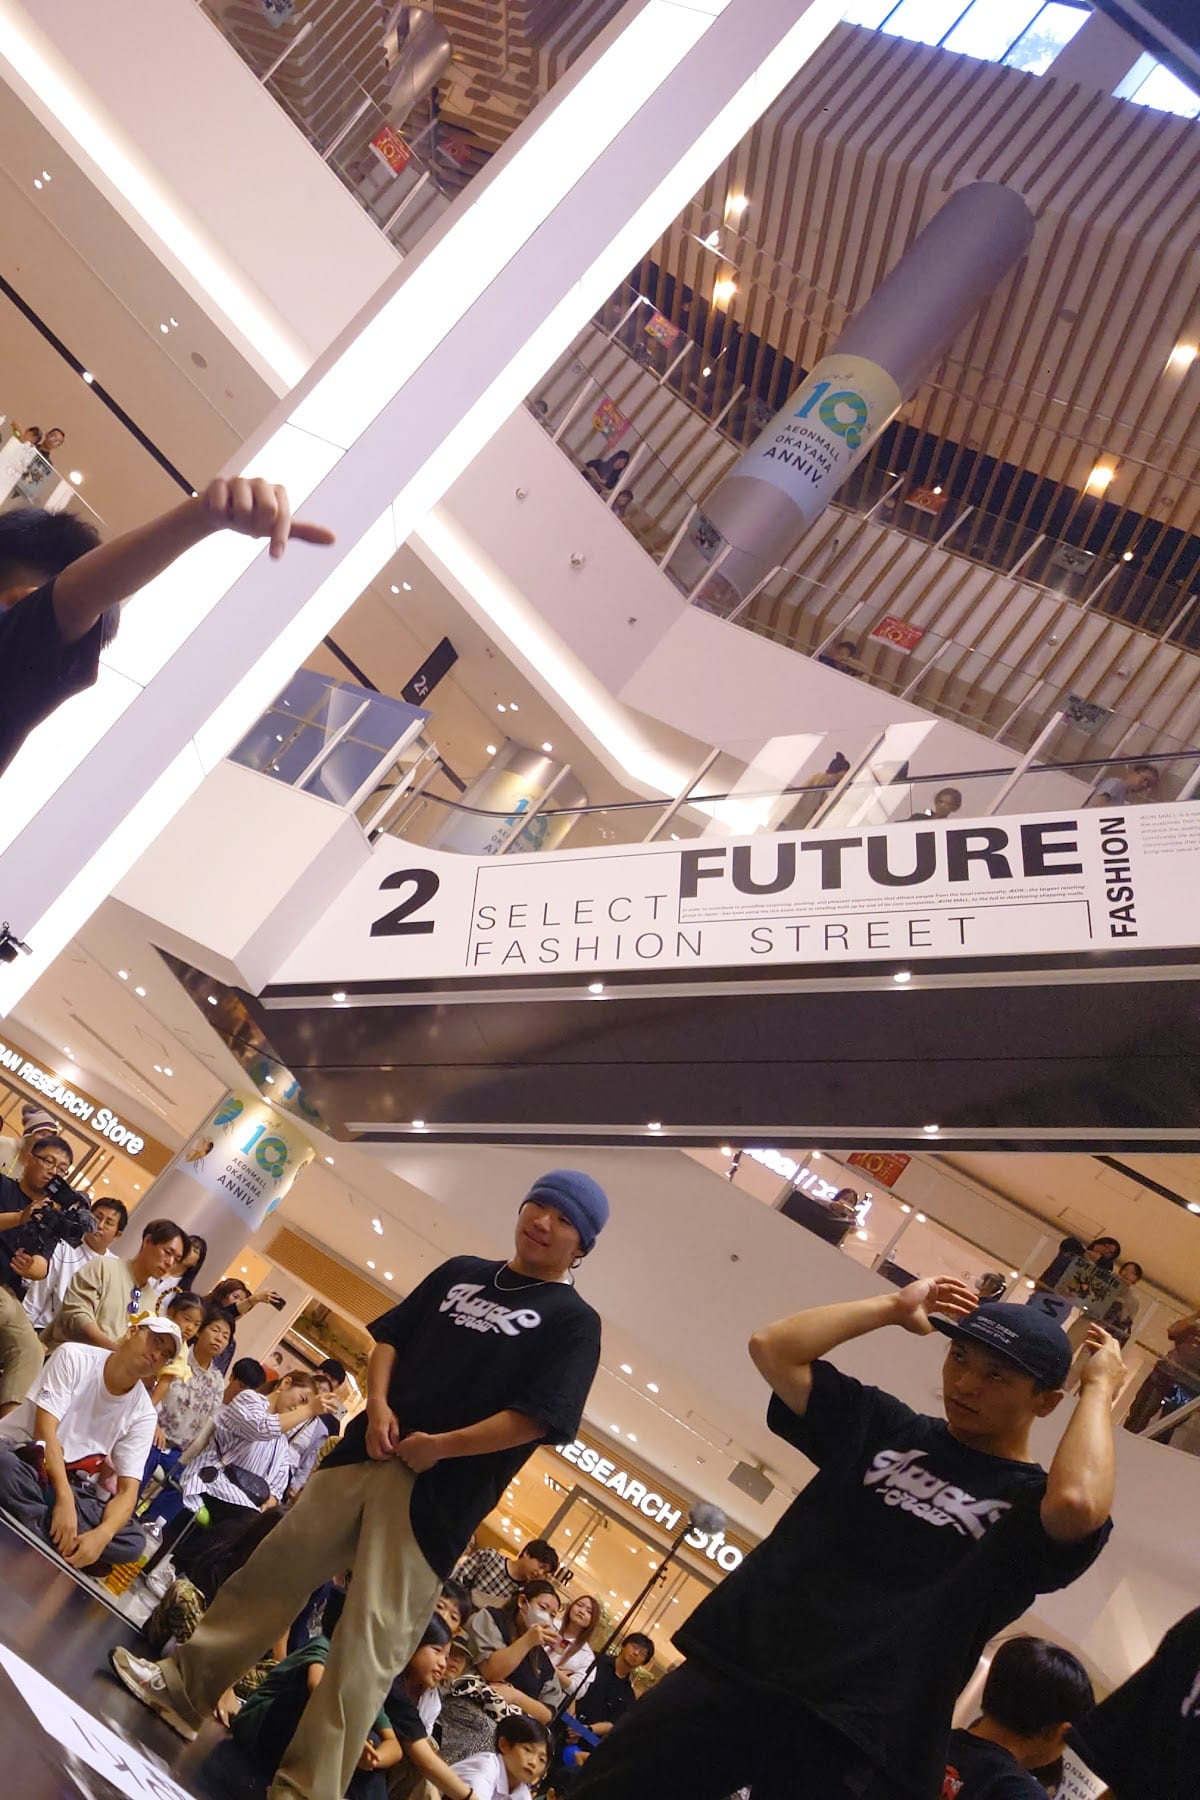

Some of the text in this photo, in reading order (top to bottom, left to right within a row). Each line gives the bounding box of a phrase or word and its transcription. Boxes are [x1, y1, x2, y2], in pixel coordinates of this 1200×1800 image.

[775, 434, 832, 474] OKAYAMA
[785, 425, 840, 462] AEONMALL
[763, 446, 822, 489] ANNIV.
[413, 675, 428, 697] 2F
[680, 820, 1084, 899] FUTURE
[1099, 816, 1138, 939] FASHION
[369, 867, 440, 938] 2
[475, 894, 668, 931] SELECT
[474, 916, 976, 967] FASHION STREET
[17, 1061, 94, 1121] RESEARCH
[91, 1108, 144, 1155] Store
[217, 1174, 255, 1209] ANNIV.
[226, 1164, 262, 1198] OKAYAMA
[232, 1157, 267, 1189] AEONMALL
[555, 1440, 744, 1571] ESEARCH Sto
